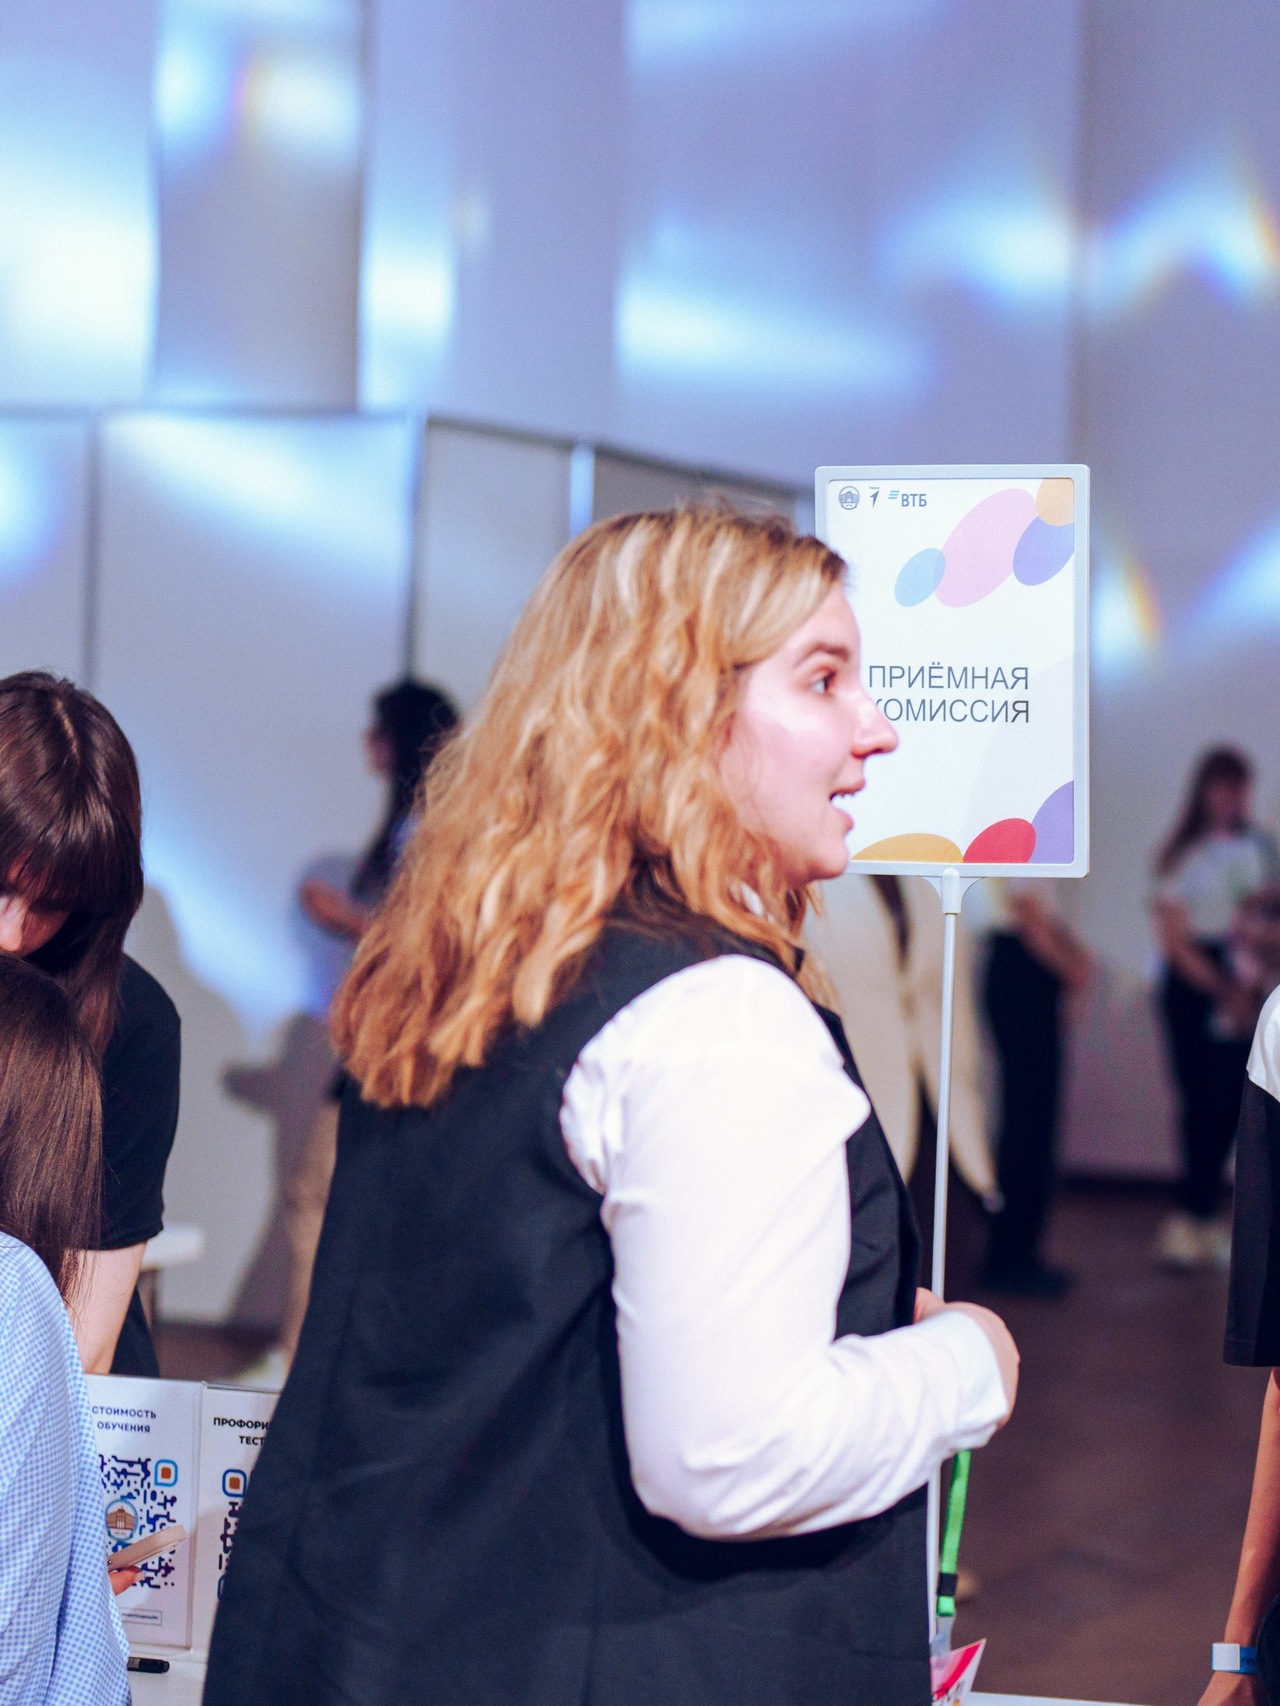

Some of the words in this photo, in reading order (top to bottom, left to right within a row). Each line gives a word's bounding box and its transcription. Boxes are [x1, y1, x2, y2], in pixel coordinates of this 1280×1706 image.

[901, 494, 927, 507] ВТБ
[869, 662, 1029, 690] ПРИЁМНАЯ
[92, 1406, 157, 1419] СТОИМОСТЬ
[97, 1421, 151, 1433] ОБУЧЕНИЯ
